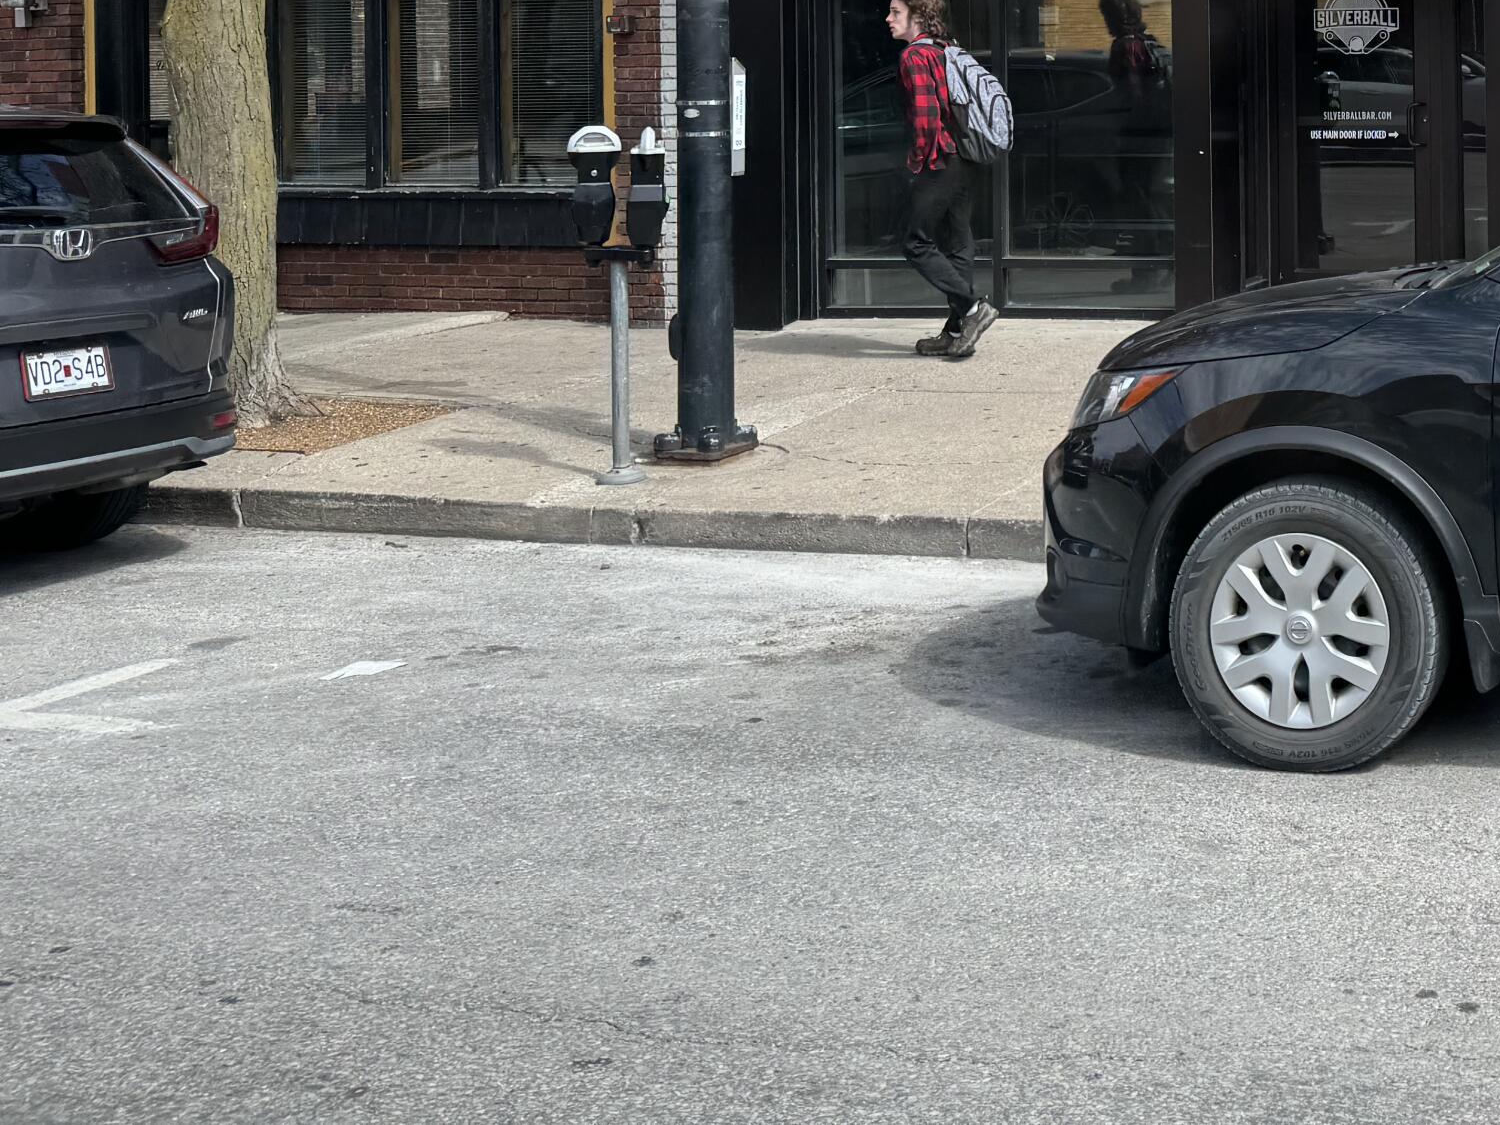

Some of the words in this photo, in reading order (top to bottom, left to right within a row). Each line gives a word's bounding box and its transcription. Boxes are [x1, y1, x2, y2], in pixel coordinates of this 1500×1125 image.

[1317, 9, 1396, 28] SILVERBALL
[1323, 111, 1392, 121] SILVERBALLBAR.COM
[1310, 130, 1322, 140] USE
[1322, 130, 1339, 140] MAIN
[1339, 130, 1357, 140] DOOR
[1357, 130, 1364, 140] IF
[1364, 130, 1387, 140] LOCKED
[28, 358, 65, 387] VD2
[71, 354, 106, 381] S4B
